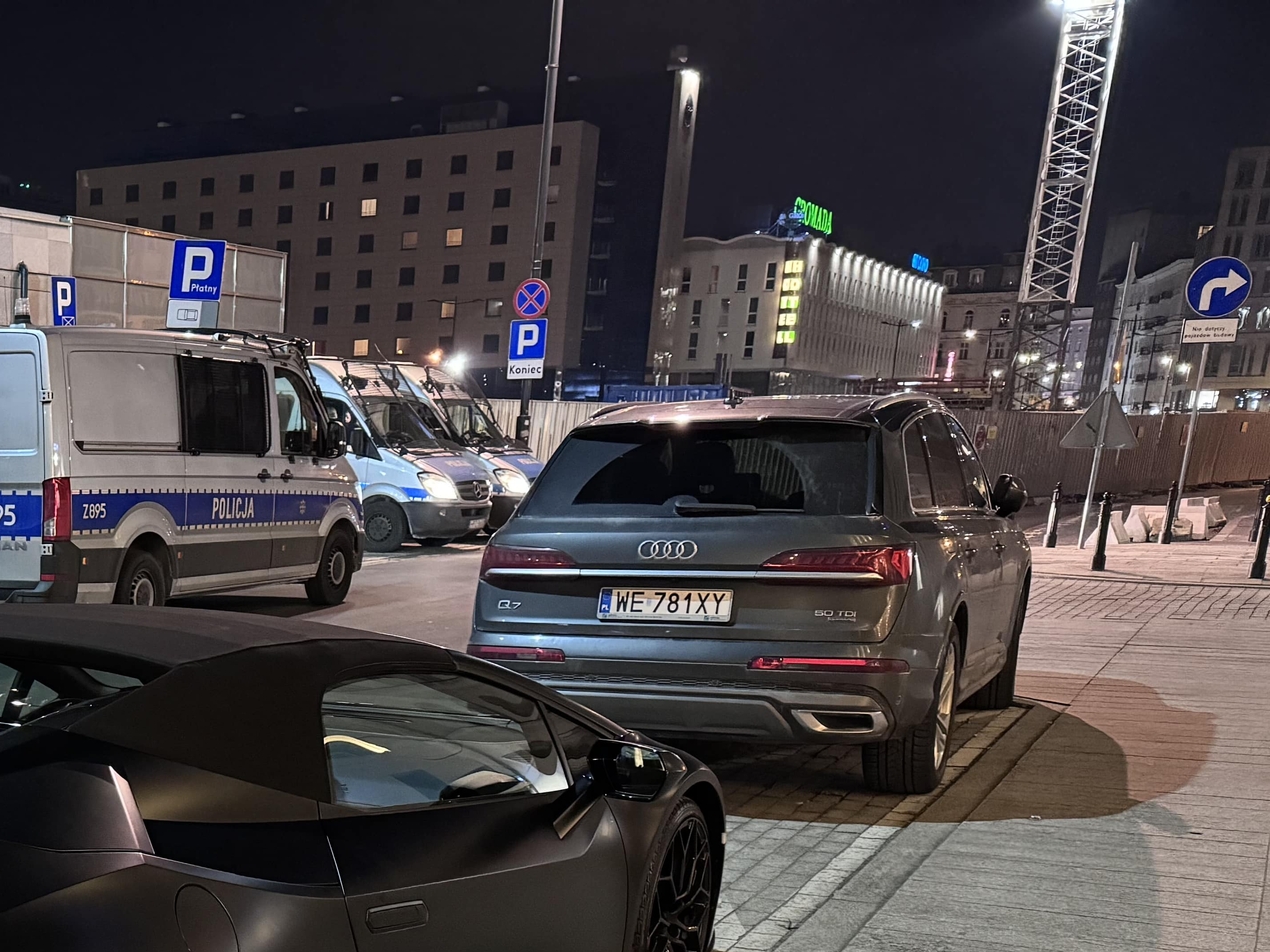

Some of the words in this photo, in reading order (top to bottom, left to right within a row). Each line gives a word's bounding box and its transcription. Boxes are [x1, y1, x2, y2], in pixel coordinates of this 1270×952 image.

[181, 246, 215, 293] P
[57, 281, 72, 316] P
[191, 283, 218, 295] Płatny
[516, 323, 540, 356] P
[510, 364, 542, 375] Koniec
[82, 503, 107, 520] Z895
[211, 497, 255, 520] POLICJA
[497, 600, 522, 610] Q7
[616, 591, 646, 613] WE
[652, 592, 727, 615] 781XY
[814, 609, 834, 617] 50
